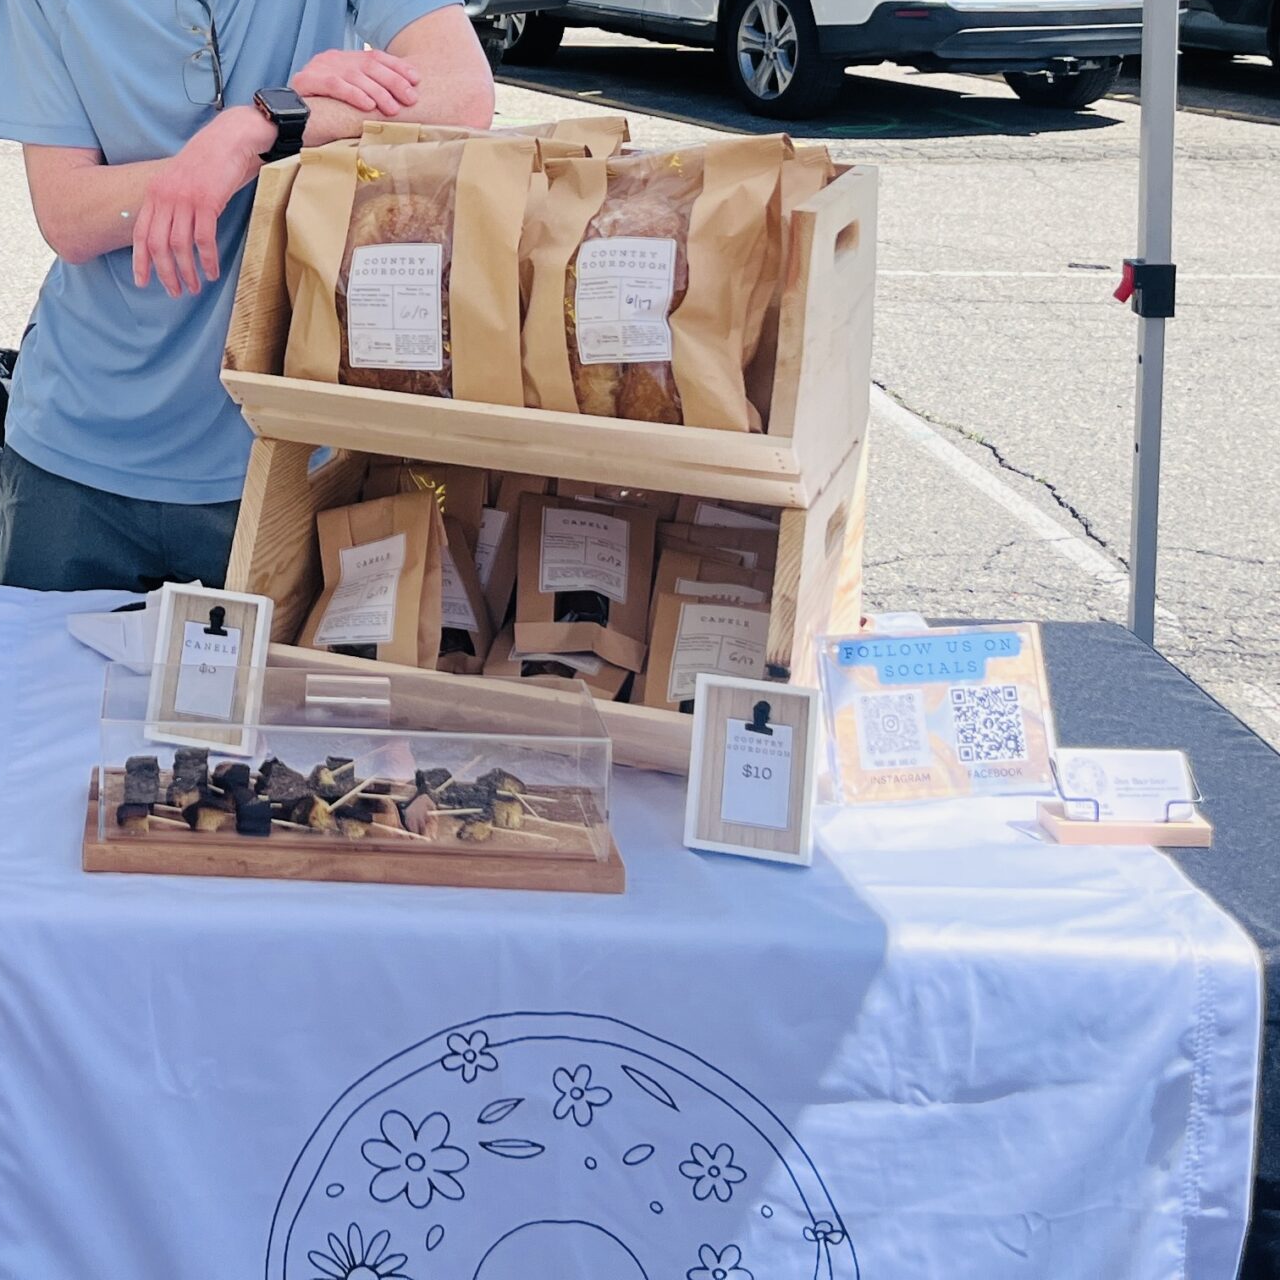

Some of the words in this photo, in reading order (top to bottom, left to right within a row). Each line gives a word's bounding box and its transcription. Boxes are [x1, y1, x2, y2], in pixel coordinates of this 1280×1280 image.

[363, 256, 427, 266] COUNTRY
[591, 249, 659, 260] COUNTRY
[354, 267, 435, 277] SOURDOUGH
[581, 259, 667, 271] SOURDOUGH
[624, 293, 653, 311] 6/17
[843, 641, 933, 661] FOLLOW
[945, 639, 973, 654] US
[983, 637, 1013, 652] ON
[884, 660, 979, 678] SOCIALS
[733, 734, 784, 748] COUNTRY
[726, 743, 791, 758] SOURDOUGH
[741, 762, 773, 780] $10
[967, 766, 1023, 780] FACEBOOK
[869, 772, 932, 786] INSTAGRAM
